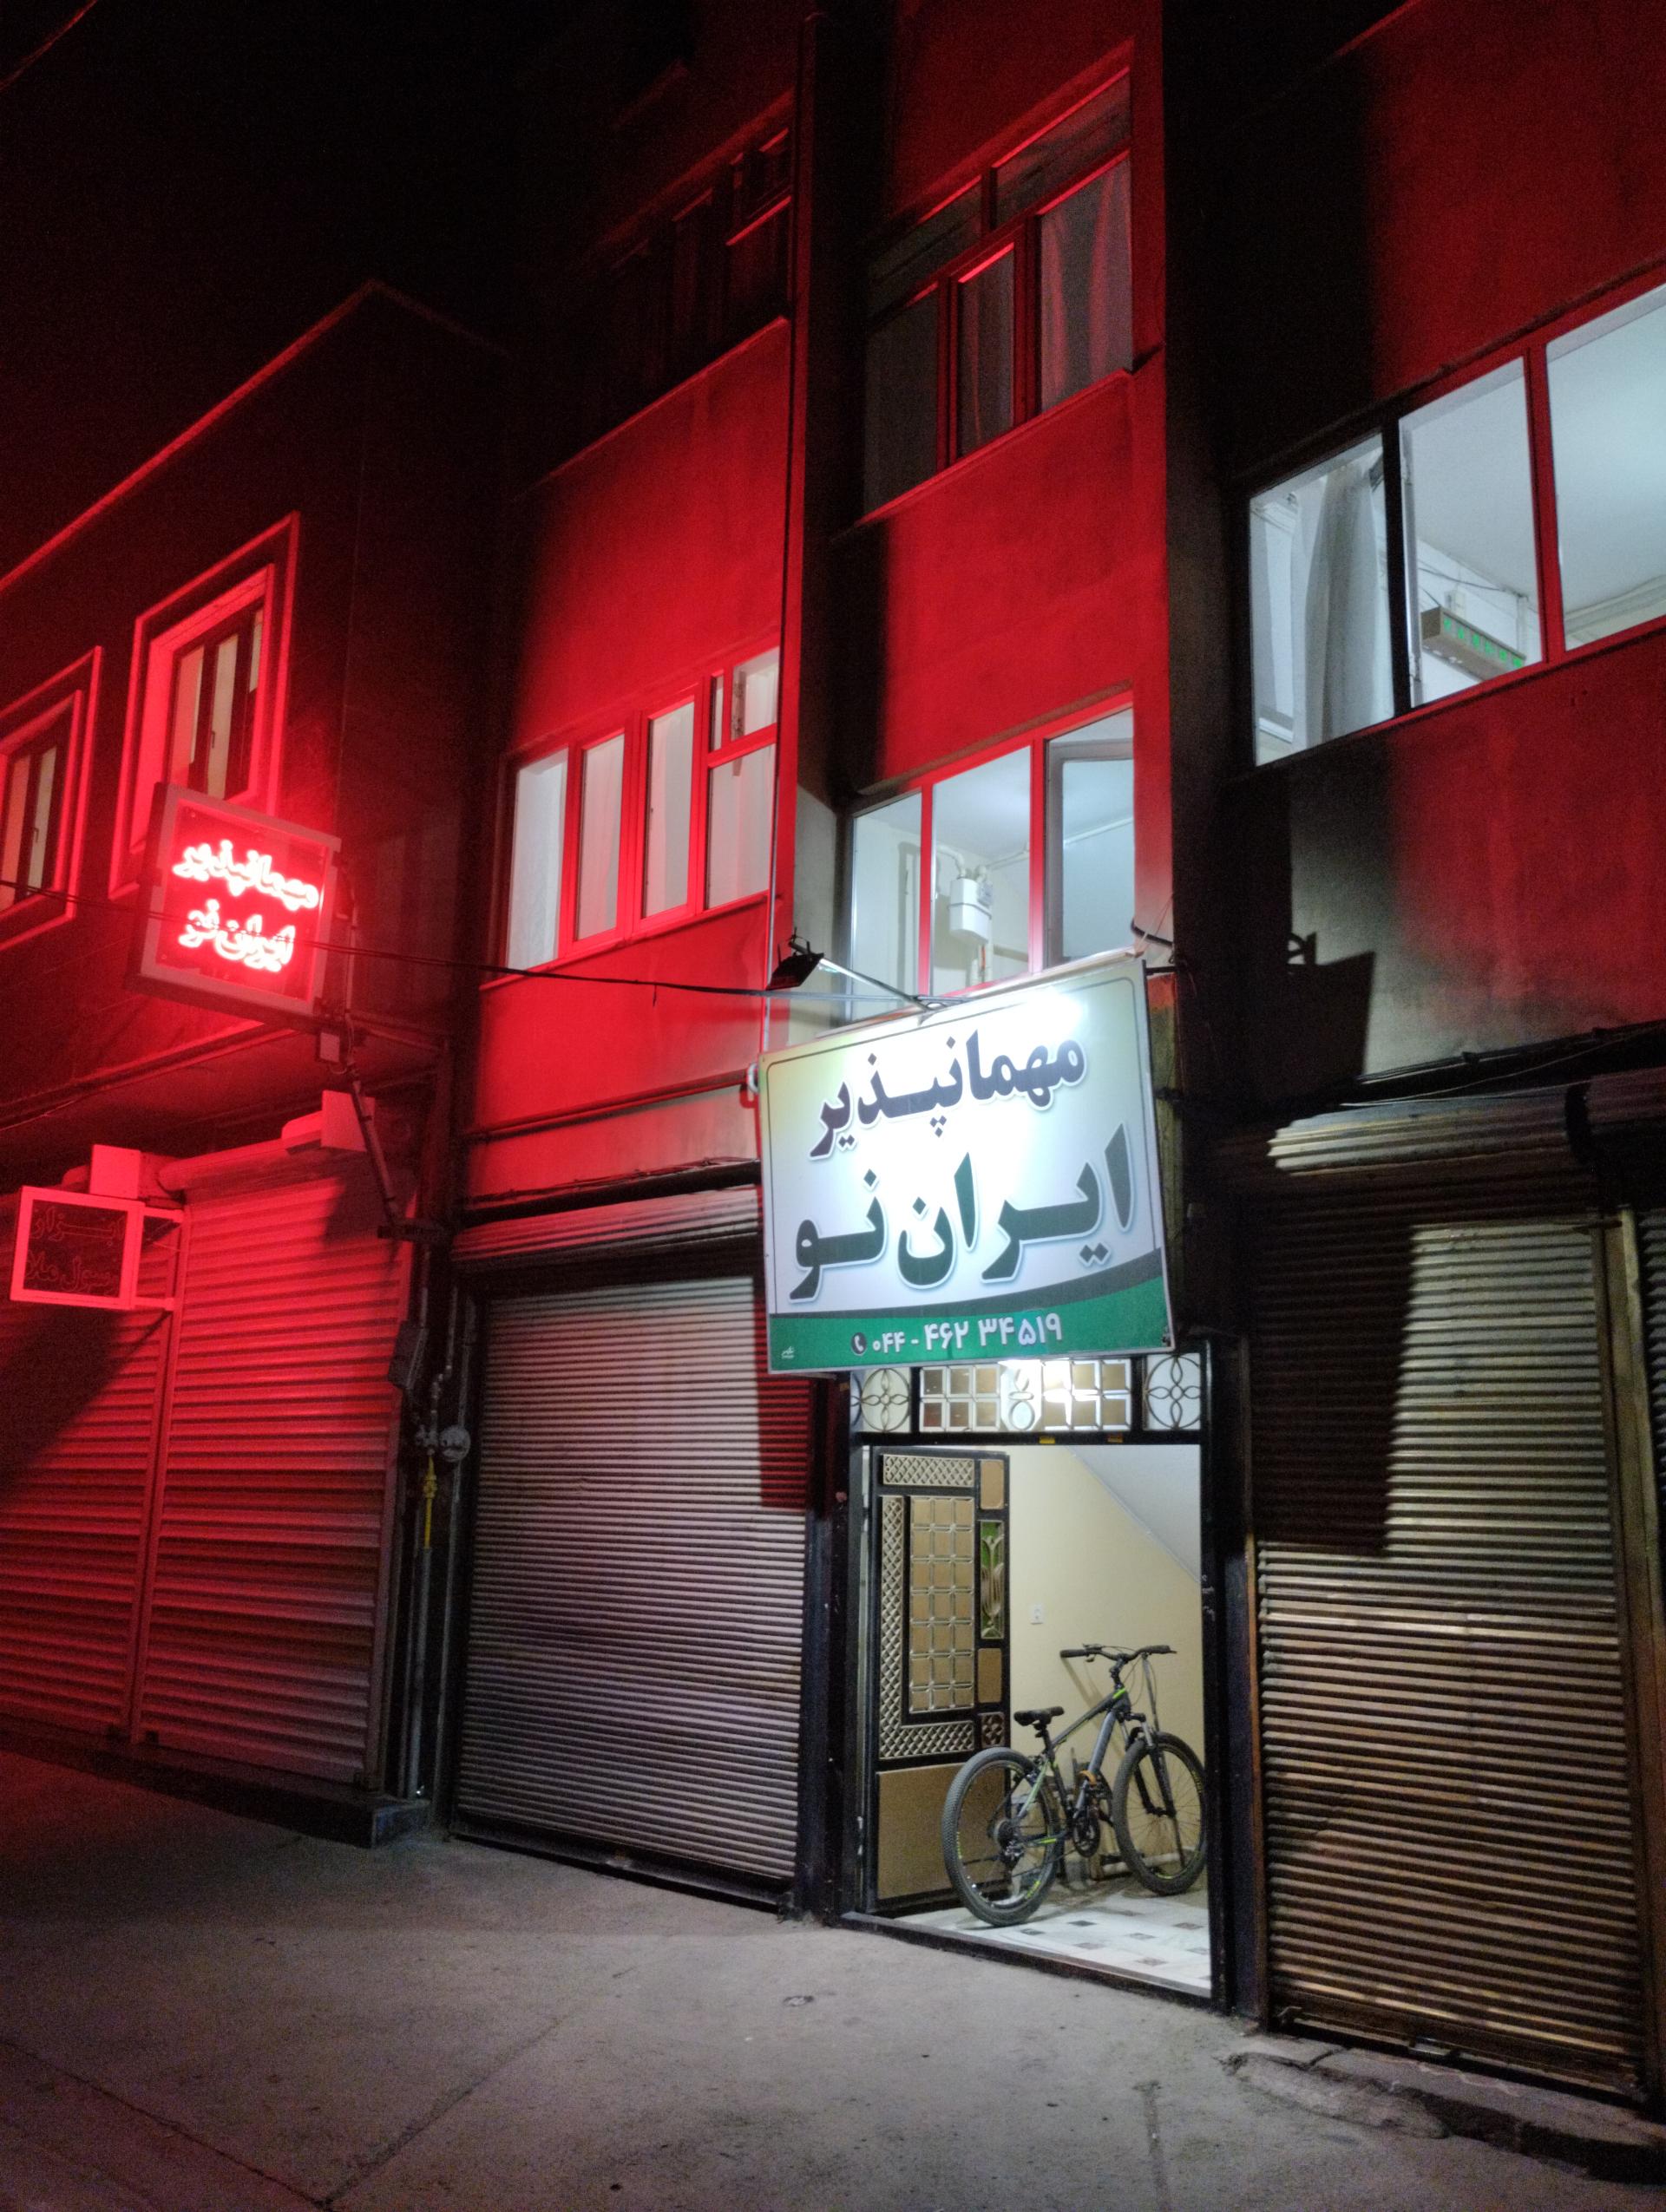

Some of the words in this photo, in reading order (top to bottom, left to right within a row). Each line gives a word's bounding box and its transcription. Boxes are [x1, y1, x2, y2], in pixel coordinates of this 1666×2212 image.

[810, 1029, 1086, 1158] مهمانپذیر
[789, 1168, 885, 1300] نو
[898, 1123, 1132, 1286] ایران
